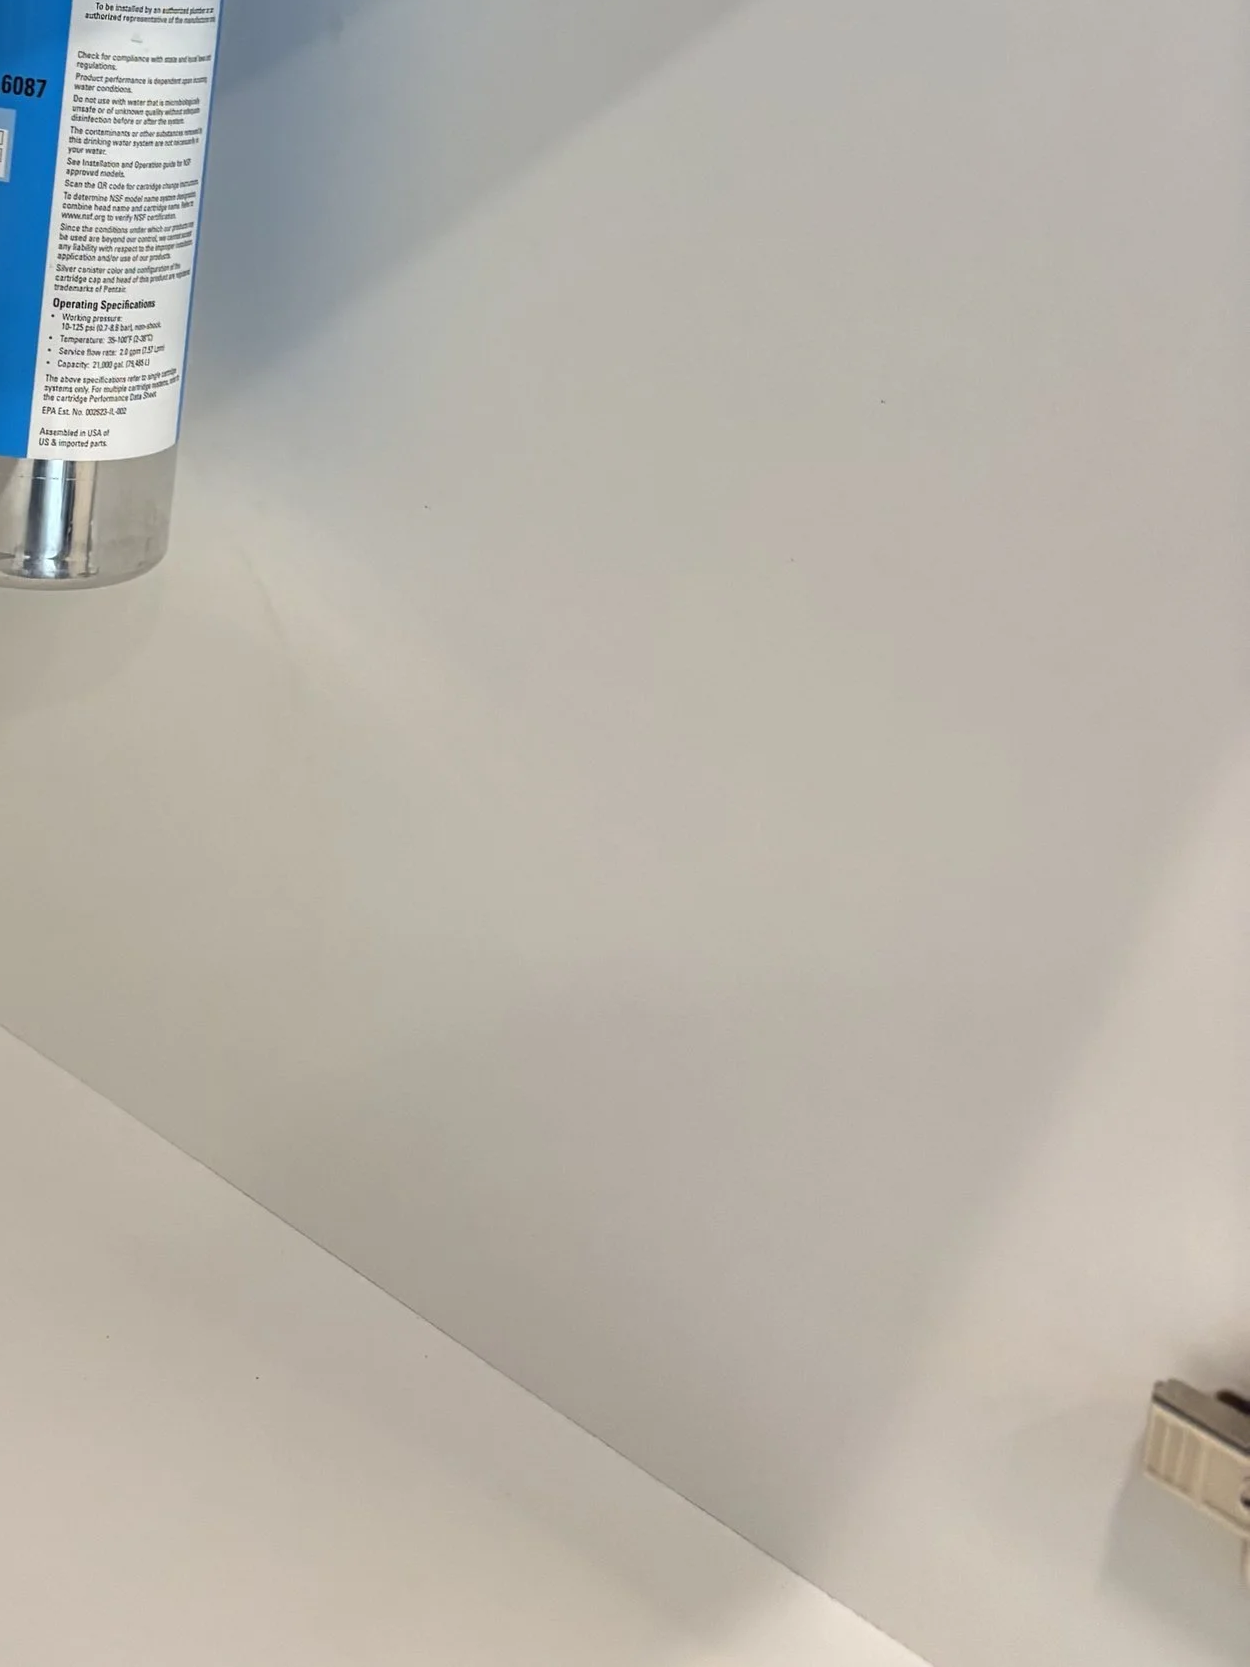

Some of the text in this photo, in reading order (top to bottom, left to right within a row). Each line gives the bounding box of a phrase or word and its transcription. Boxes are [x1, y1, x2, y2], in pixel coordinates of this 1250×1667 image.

[116, 4, 143, 13] installed
[145, 6, 152, 14] by
[85, 13, 121, 22] authorized
[78, 51, 99, 60] Check
[75, 73, 146, 84] Product performance
[74, 84, 95, 92] water
[73, 105, 96, 114] unsafe
[113, 117, 133, 125] before
[70, 126, 83, 134] The
[84, 137, 111, 147] drinking
[67, 158, 80, 166] See
[66, 168, 99, 177] approved
[65, 180, 95, 189] Scan the
[64, 192, 71, 200] To
[60, 223, 93, 232] Since the
[70, 234, 86, 242] used
[58, 243, 70, 251] any
[57, 253, 96, 262] application
[56, 264, 76, 273] Silver
[55, 274, 100, 284] cartridge cap
[53, 298, 155, 312] Operating Specifications
[62, 314, 91, 323] Working
[59, 347, 85, 355] Service
[58, 360, 90, 369] Capacity:
[46, 374, 58, 382] The
[92, 385, 102, 393] For
[56, 394, 87, 404] cartridge
[42, 406, 56, 414] EPA
[40, 428, 78, 437] Assembled
[39, 438, 88, 448] US imported
